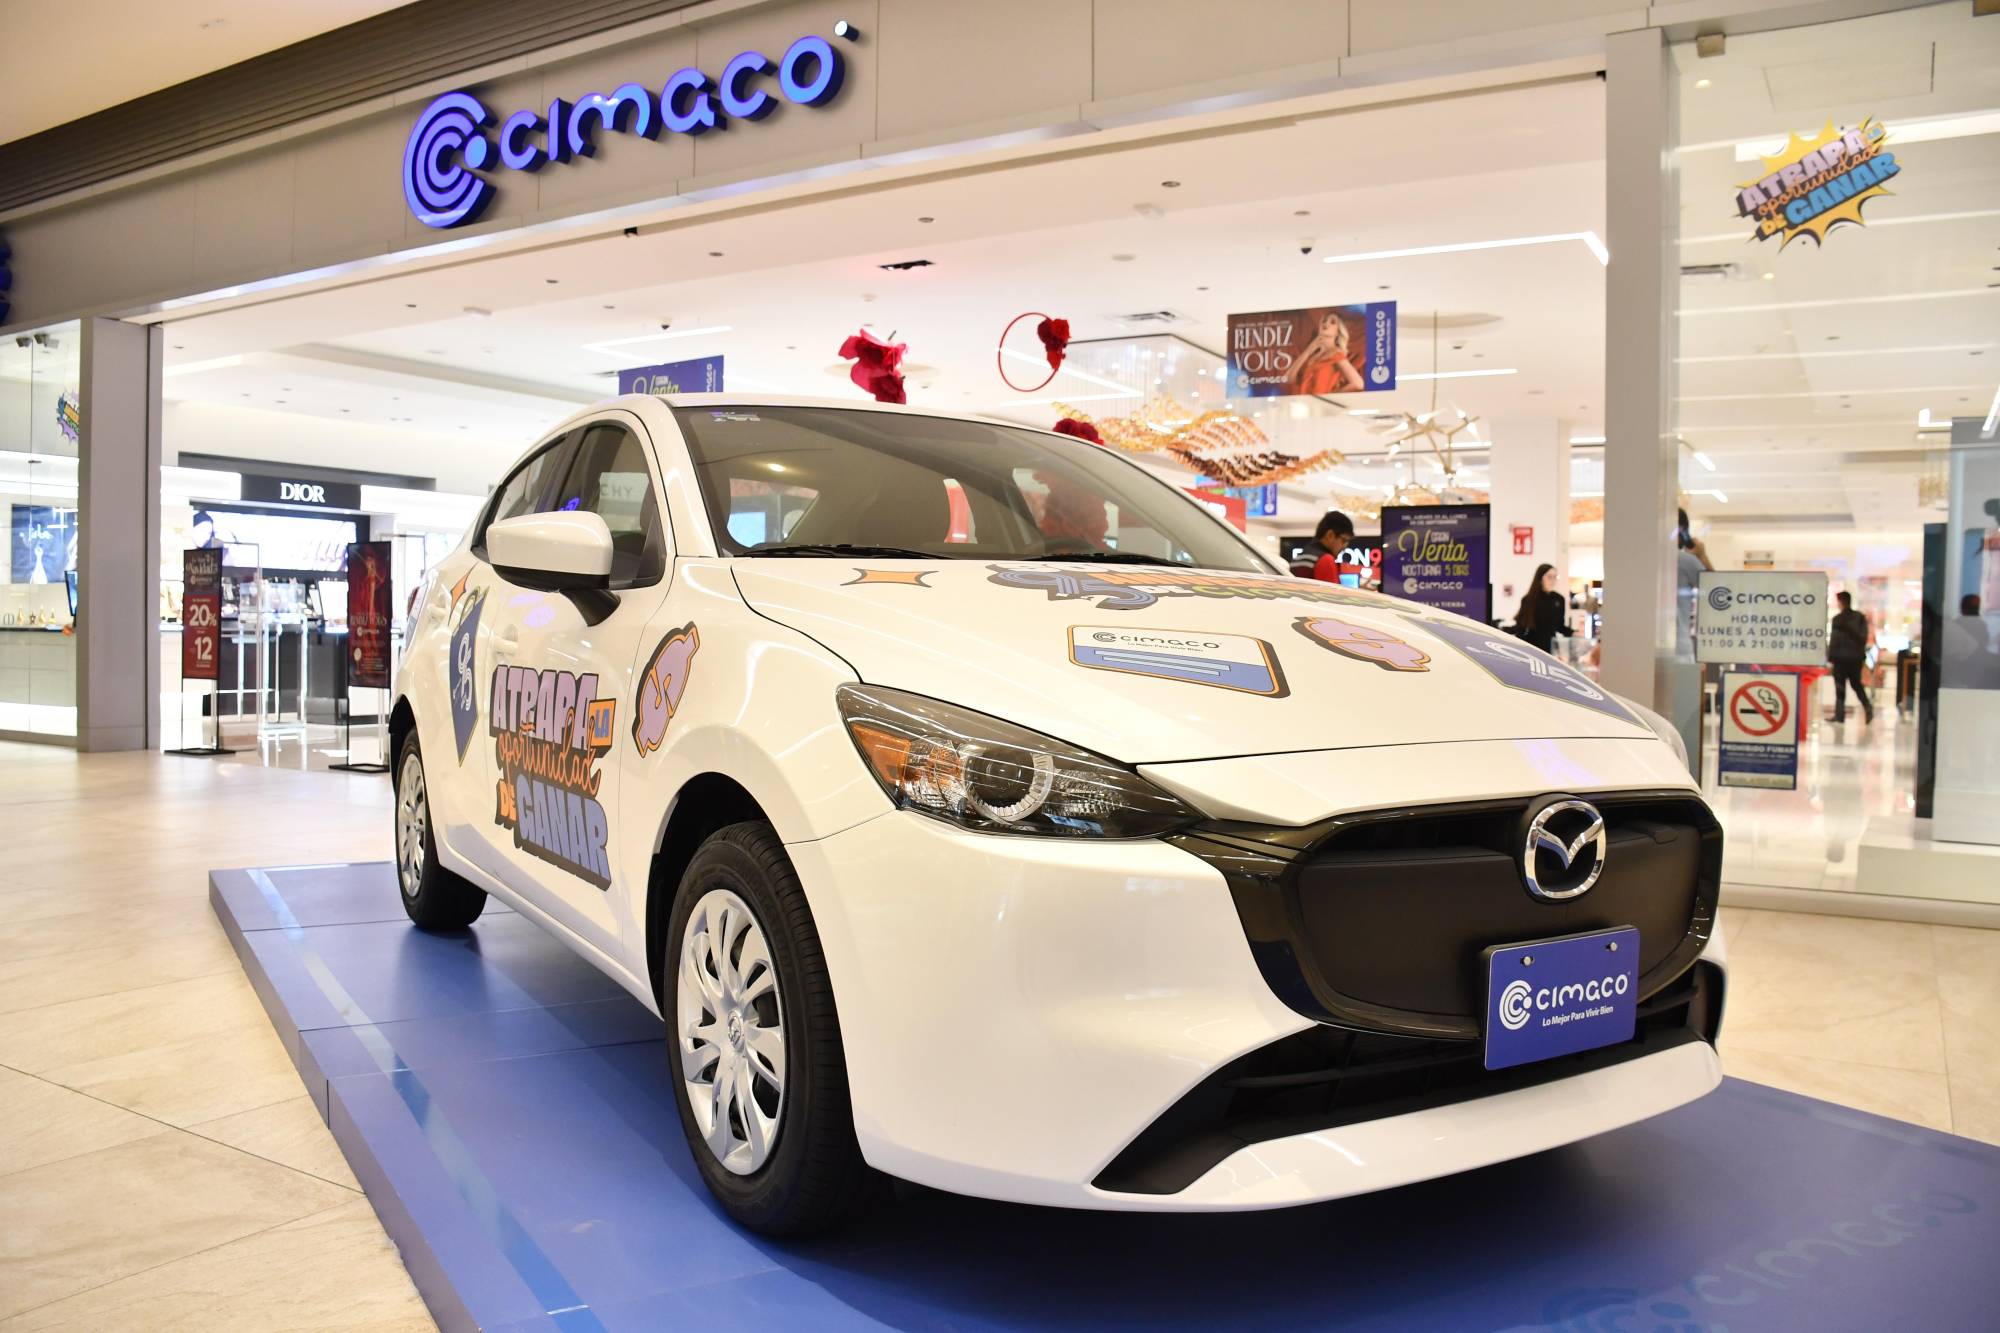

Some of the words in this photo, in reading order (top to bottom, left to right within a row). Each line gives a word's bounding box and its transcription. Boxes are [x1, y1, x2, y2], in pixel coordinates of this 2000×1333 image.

[1740, 128, 1866, 213] ATRAPA
[1785, 152, 1901, 225] GANAR
[1234, 324, 1293, 349] RENDEZ
[1234, 350, 1293, 373] VOUS
[280, 482, 326, 503] DIOR
[1398, 529, 1468, 562] Venta
[1736, 592, 1816, 605] cimaco
[1699, 626, 1742, 636] LUNES
[1747, 627, 1756, 636] A
[1760, 627, 1824, 637] DOMINGO
[1731, 614, 1793, 624] HORARIO
[194, 635, 213, 661] 12
[1120, 635, 1220, 649] cimaco
[1702, 638, 1734, 648] 11:00
[1739, 639, 1747, 648] A
[1751, 639, 1786, 649] 21:00
[1790, 640, 1822, 650] HRS.
[491, 665, 599, 751] ATRAPA
[593, 707, 611, 739] LA
[499, 706, 602, 796] oportunidad
[499, 780, 517, 821] DE
[516, 773, 612, 885] GANAR
[1535, 973, 1629, 1011] cimaco
[1542, 1017, 1551, 1027] Lo
[1551, 1013, 1571, 1026] Mejor
[1570, 1011, 1586, 1021] Para
[1585, 1007, 1600, 1018] Vivir
[1600, 1005, 1614, 1015] Bien
